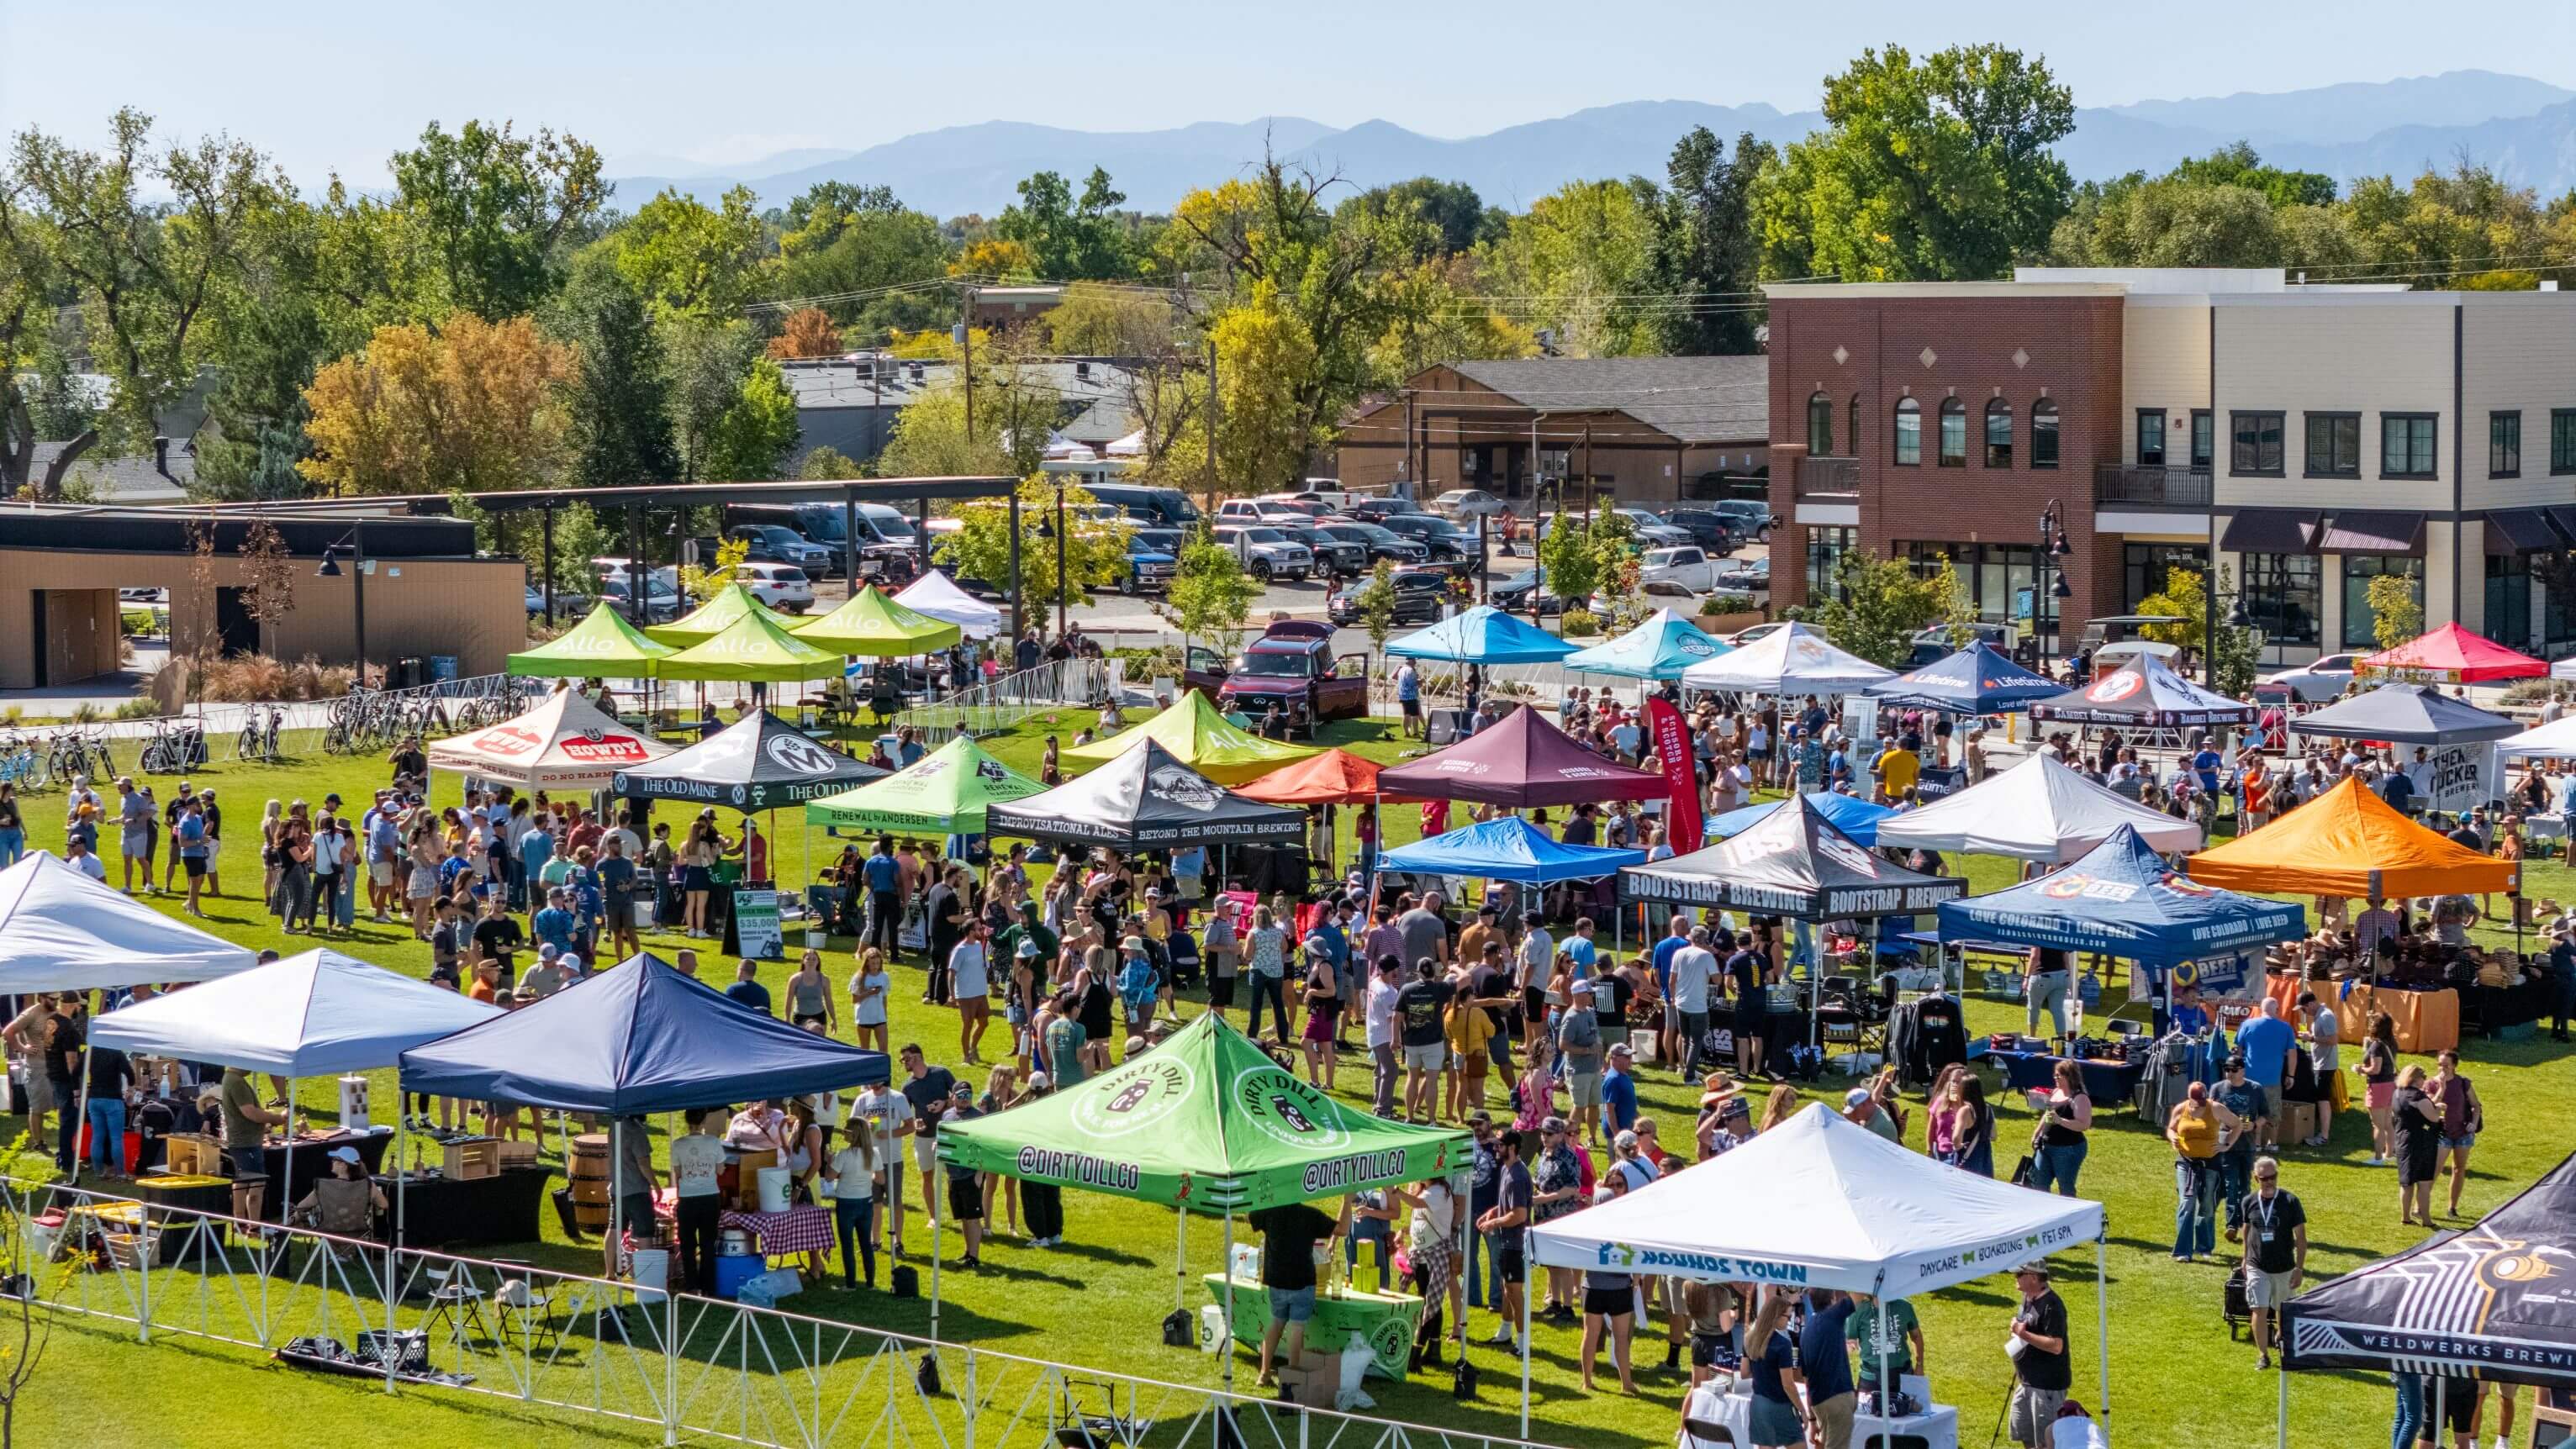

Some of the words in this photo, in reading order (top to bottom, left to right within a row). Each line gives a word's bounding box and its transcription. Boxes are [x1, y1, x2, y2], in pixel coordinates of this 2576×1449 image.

[1914, 673, 1971, 688] Lifetime
[1997, 676, 2052, 688] Lifetime
[566, 740, 641, 756] HOWDY
[560, 772, 575, 781] NO
[578, 770, 613, 780] HARM
[643, 778, 664, 793] THE
[664, 778, 689, 795] OLD
[689, 780, 719, 798] MINE
[786, 785, 814, 801] THE
[814, 782, 842, 799] OLD
[831, 809, 873, 822] RENEWAL
[882, 812, 928, 825] ANDERSEN
[999, 815, 1090, 836] IMPROVISATIONAL
[1091, 825, 1119, 840] ALES
[1138, 827, 1178, 840] BEYOND
[1181, 825, 1201, 837] THE
[1202, 823, 1254, 835] MOUNTAIN
[1257, 822, 1302, 835] BREWING
[1628, 873, 1723, 903] BOOTSTRAP
[1730, 883, 1808, 913] BREWING
[1829, 887, 1902, 914] BOOTSTRAP
[1905, 885, 1961, 909] BREWING
[1969, 909, 1997, 925] LOVE
[1998, 912, 2061, 931] COLORADO
[2076, 920, 2106, 936] LOVE
[2192, 926, 2211, 941] LOVE
[2212, 919, 2249, 938] COLORADO
[2255, 916, 2272, 930] LOVE
[2272, 914, 2289, 925] BEER
[2198, 957, 2237, 979] BEER
[1099, 1062, 1167, 1092] DIRTY
[1161, 1067, 1184, 1099] DILL
[1244, 1075, 1272, 1117] DIRTY
[1275, 1075, 1321, 1111] DILL
[1016, 1144, 1140, 1192] @DIRTYDILLCO
[1302, 1148, 1407, 1194] @DIRTYDILLCO
[1919, 1255, 1959, 1278] DAYCARE
[1978, 1239, 2024, 1262] BOARDING
[2041, 1228, 2059, 1245] PET
[2058, 1224, 2073, 1241] SPA
[1735, 1260, 1808, 1283] TOWN
[2362, 1333, 2493, 1358] WELDWERKS
